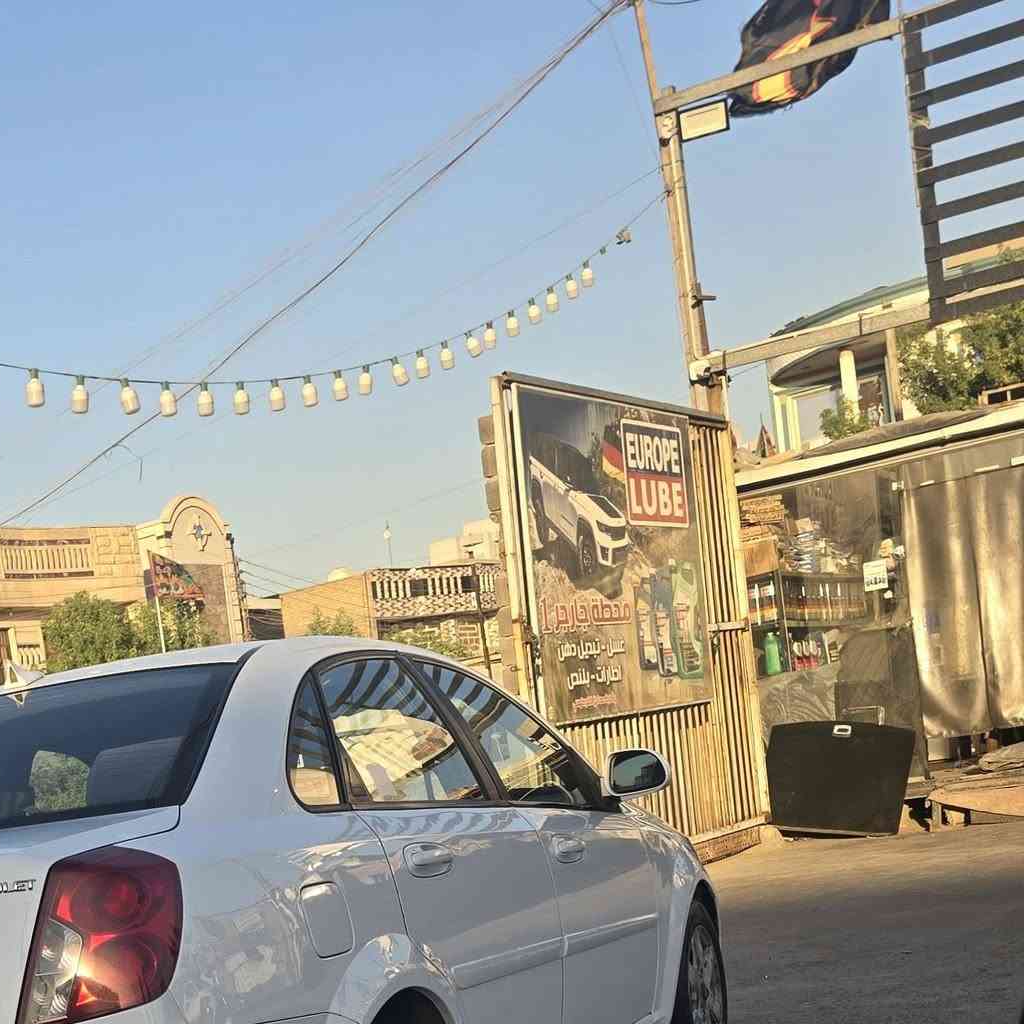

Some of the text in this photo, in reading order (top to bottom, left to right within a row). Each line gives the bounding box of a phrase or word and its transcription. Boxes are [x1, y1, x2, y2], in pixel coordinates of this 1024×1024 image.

[625, 431, 681, 474] EUROPE
[629, 478, 684, 517] LUBE
[557, 640, 577, 662] دهن
[578, 638, 601, 659] تبديل
[596, 664, 622, 686] اطارات
